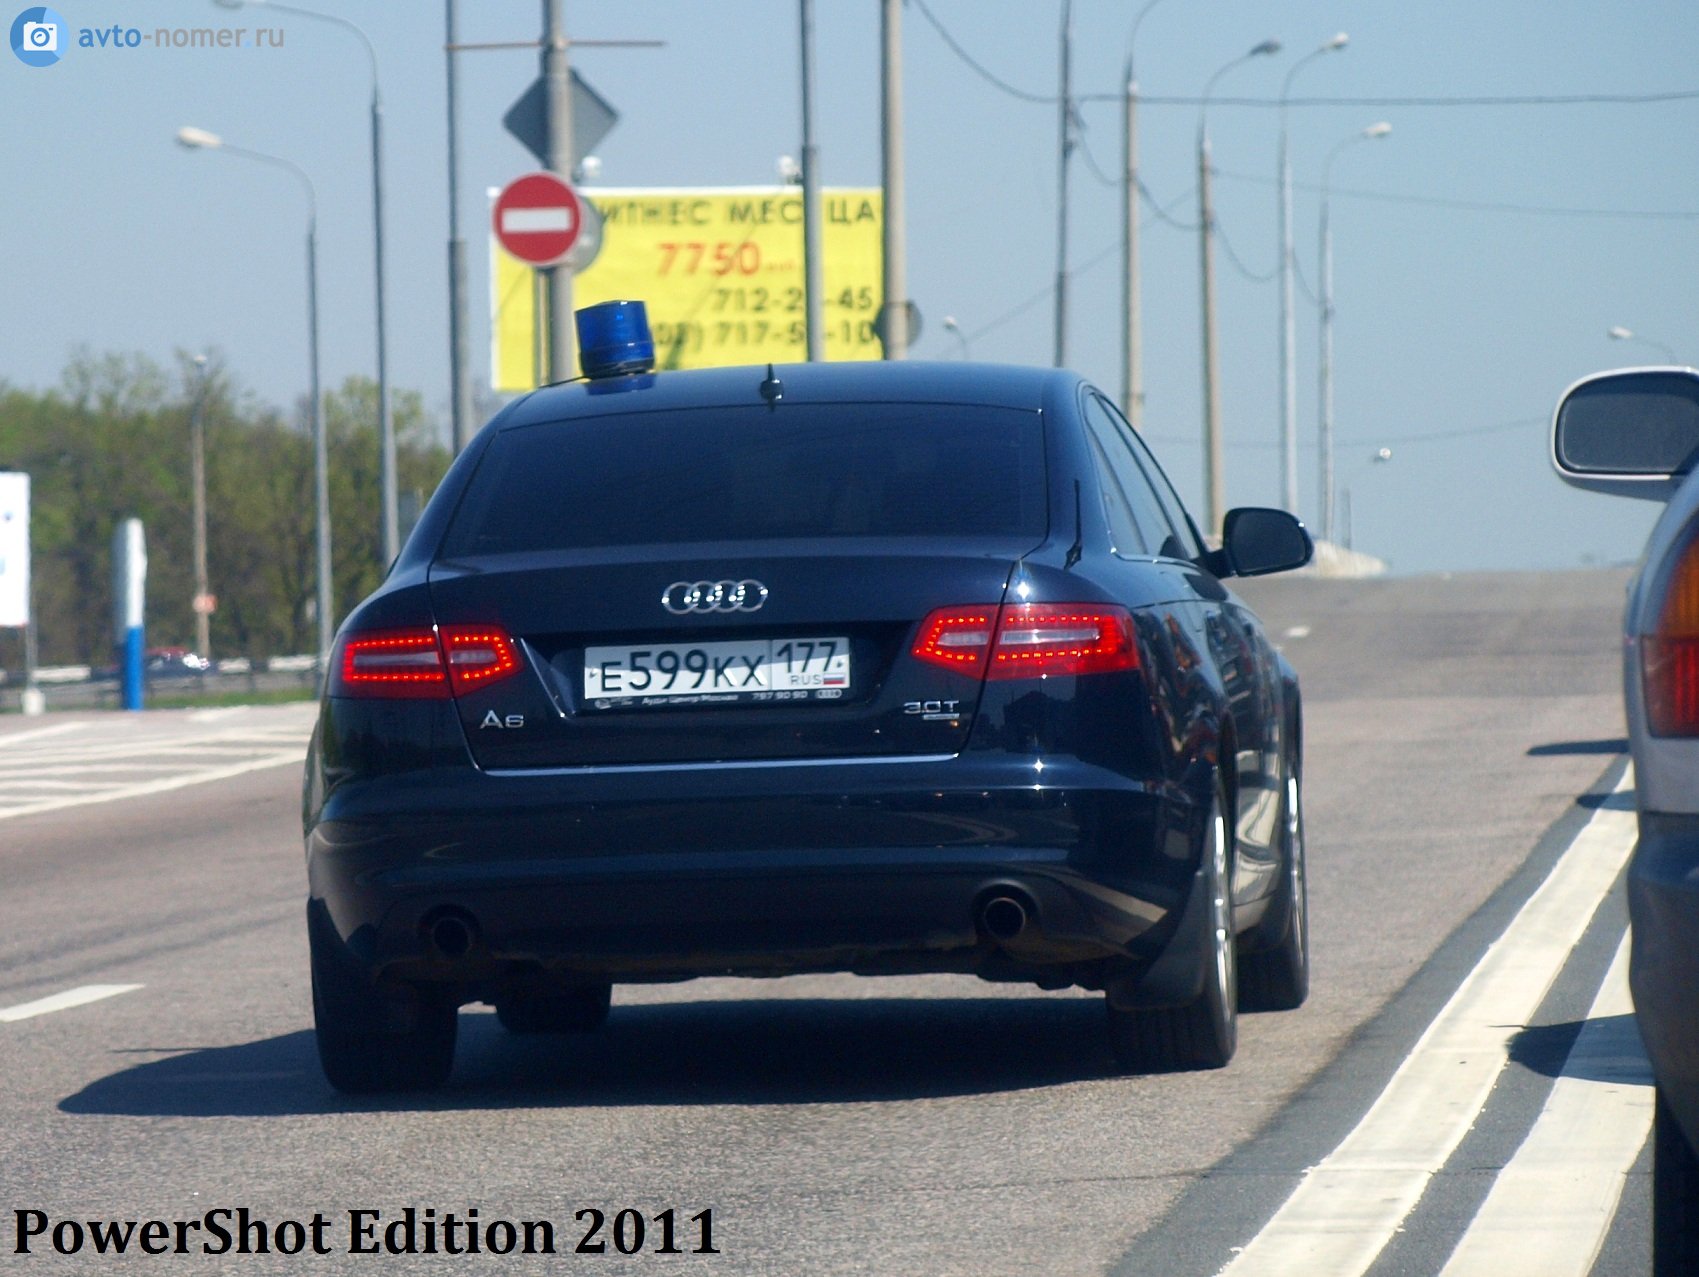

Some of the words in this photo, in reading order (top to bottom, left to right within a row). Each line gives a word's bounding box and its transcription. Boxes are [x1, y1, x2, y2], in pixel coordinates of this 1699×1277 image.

[599, 199, 712, 226] ИТНЕС
[728, 198, 877, 226] МЕСЦА
[655, 241, 762, 277] 7750
[711, 288, 873, 312] 712-2-45
[712, 320, 874, 345] 717-5-10
[777, 641, 838, 674] 177
[791, 674, 822, 685] RUS
[480, 709, 525, 729] A6
